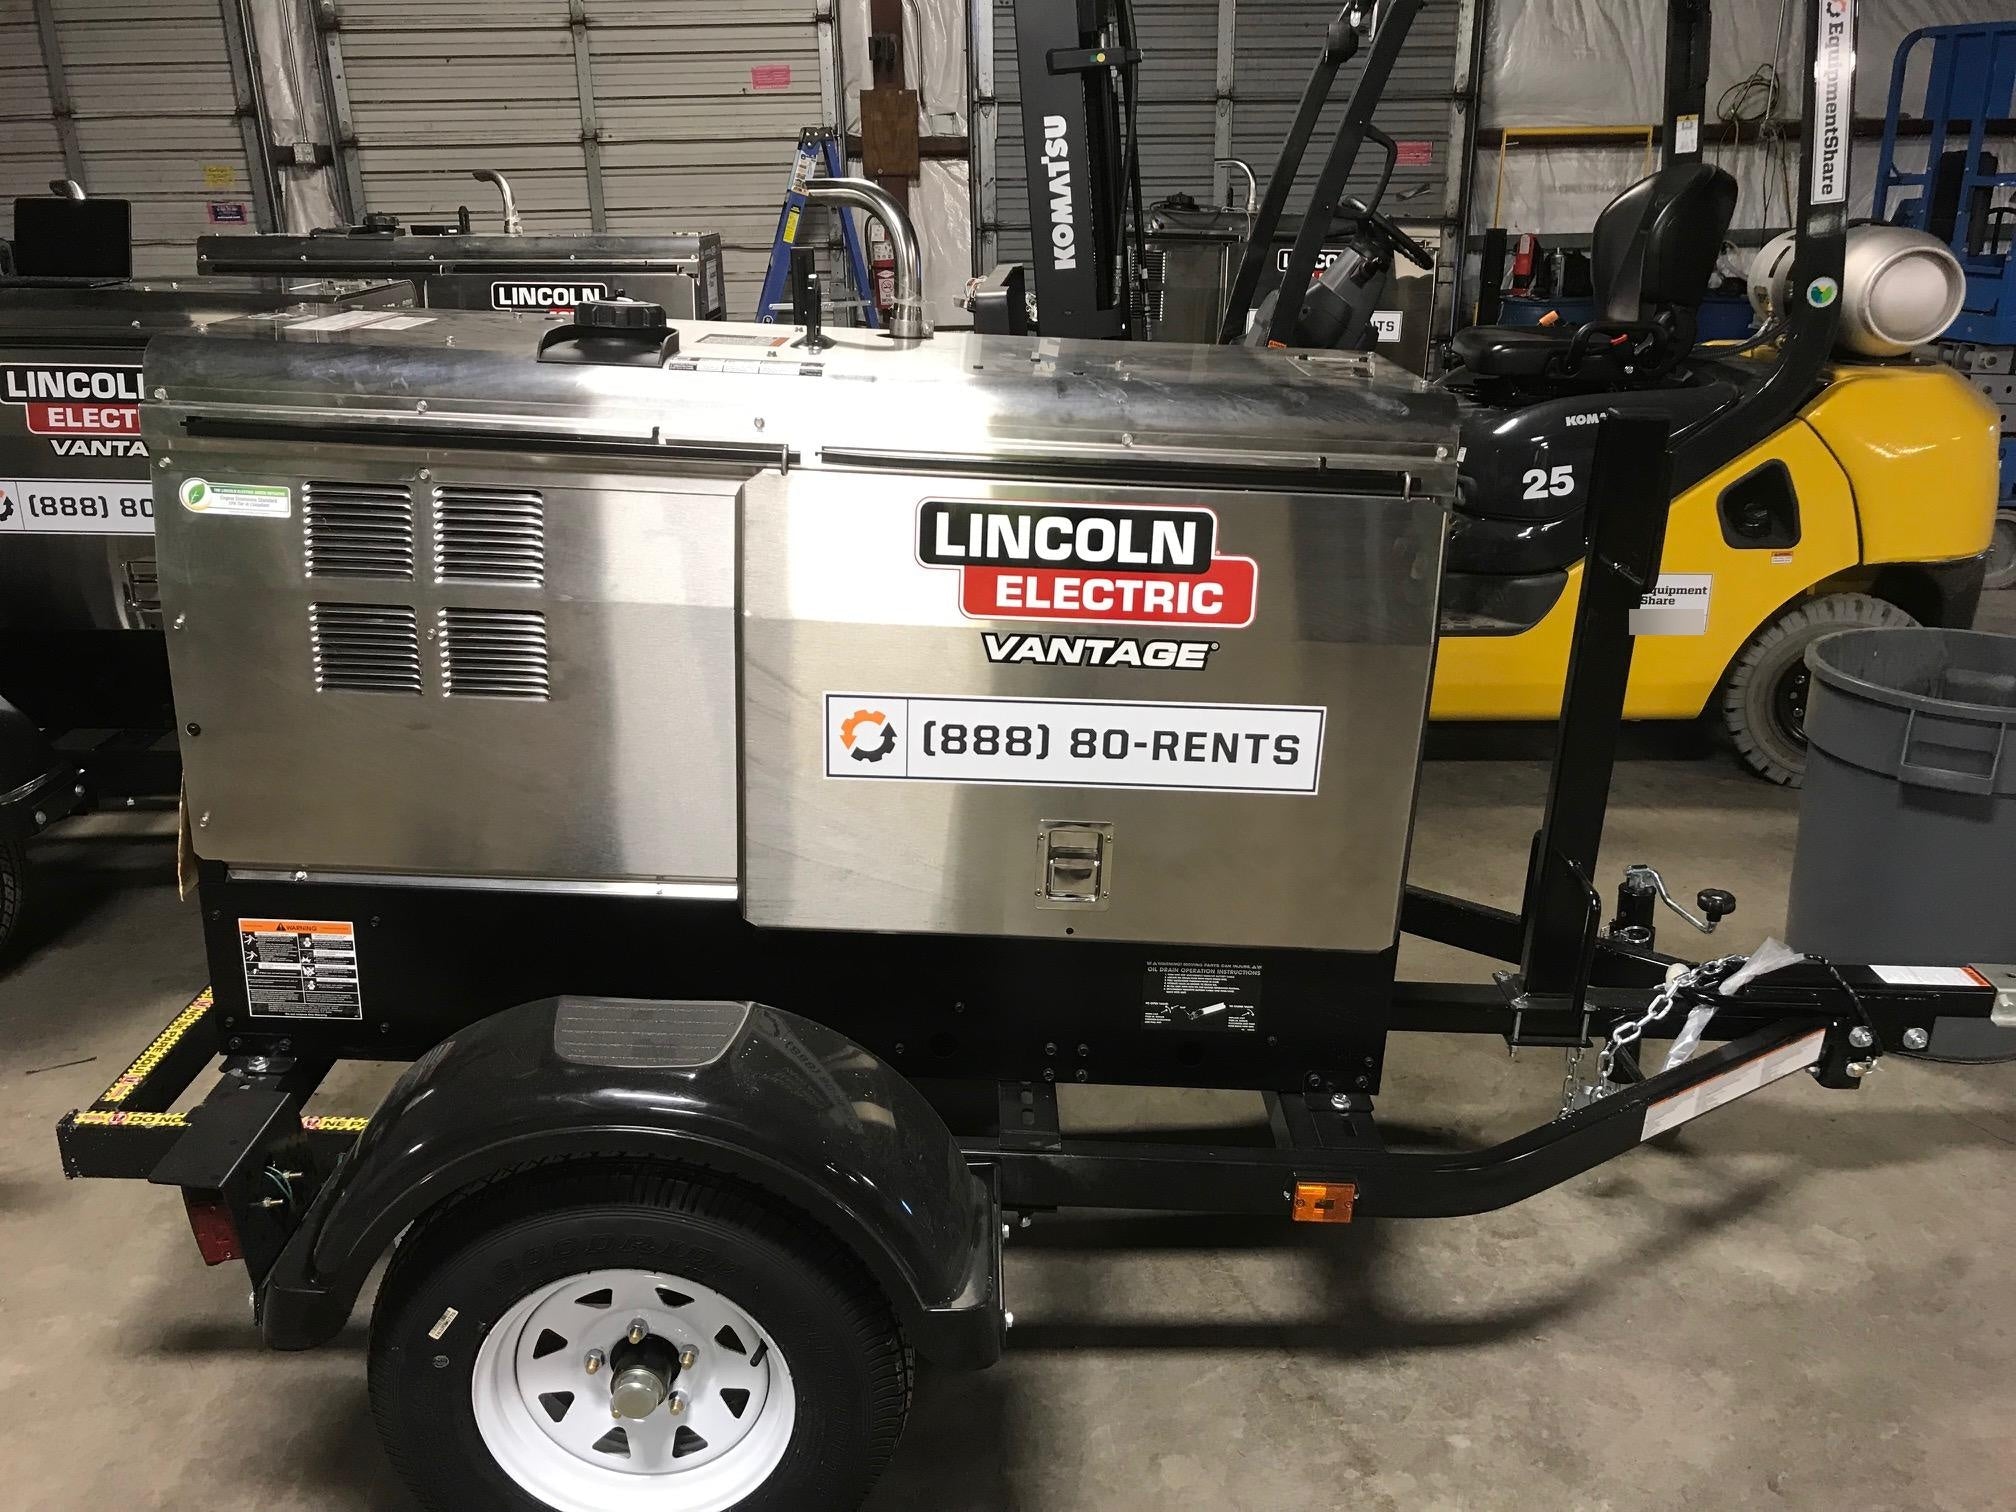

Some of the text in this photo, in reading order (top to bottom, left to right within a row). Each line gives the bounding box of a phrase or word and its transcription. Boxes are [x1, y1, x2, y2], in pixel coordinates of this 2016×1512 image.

[1821, 22, 1845, 196] EquipmentShare
[1041, 114, 1077, 271] KOMATSU
[499, 286, 600, 306] LINCOLN
[1374, 320, 1395, 333] TS
[47, 407, 140, 429] ELECT
[50, 439, 150, 458] VANTA
[1522, 464, 1575, 500] 25
[28, 494, 154, 519] (888) 80
[935, 511, 1197, 566] LINCOLN
[996, 574, 1224, 615] ELECTRIC
[1641, 596, 1676, 606] Share
[1652, 585, 1708, 597] quipment
[984, 635, 1210, 670] VANTAGE
[923, 720, 1301, 766] (888) 80-RENTS
[1180, 967, 1216, 975] OPERATION
[1216, 968, 1261, 976] INSTRUCTIONS
[185, 1008, 201, 1020] NO
[152, 1030, 179, 1054] PARE
[132, 1053, 157, 1075] AQUI
